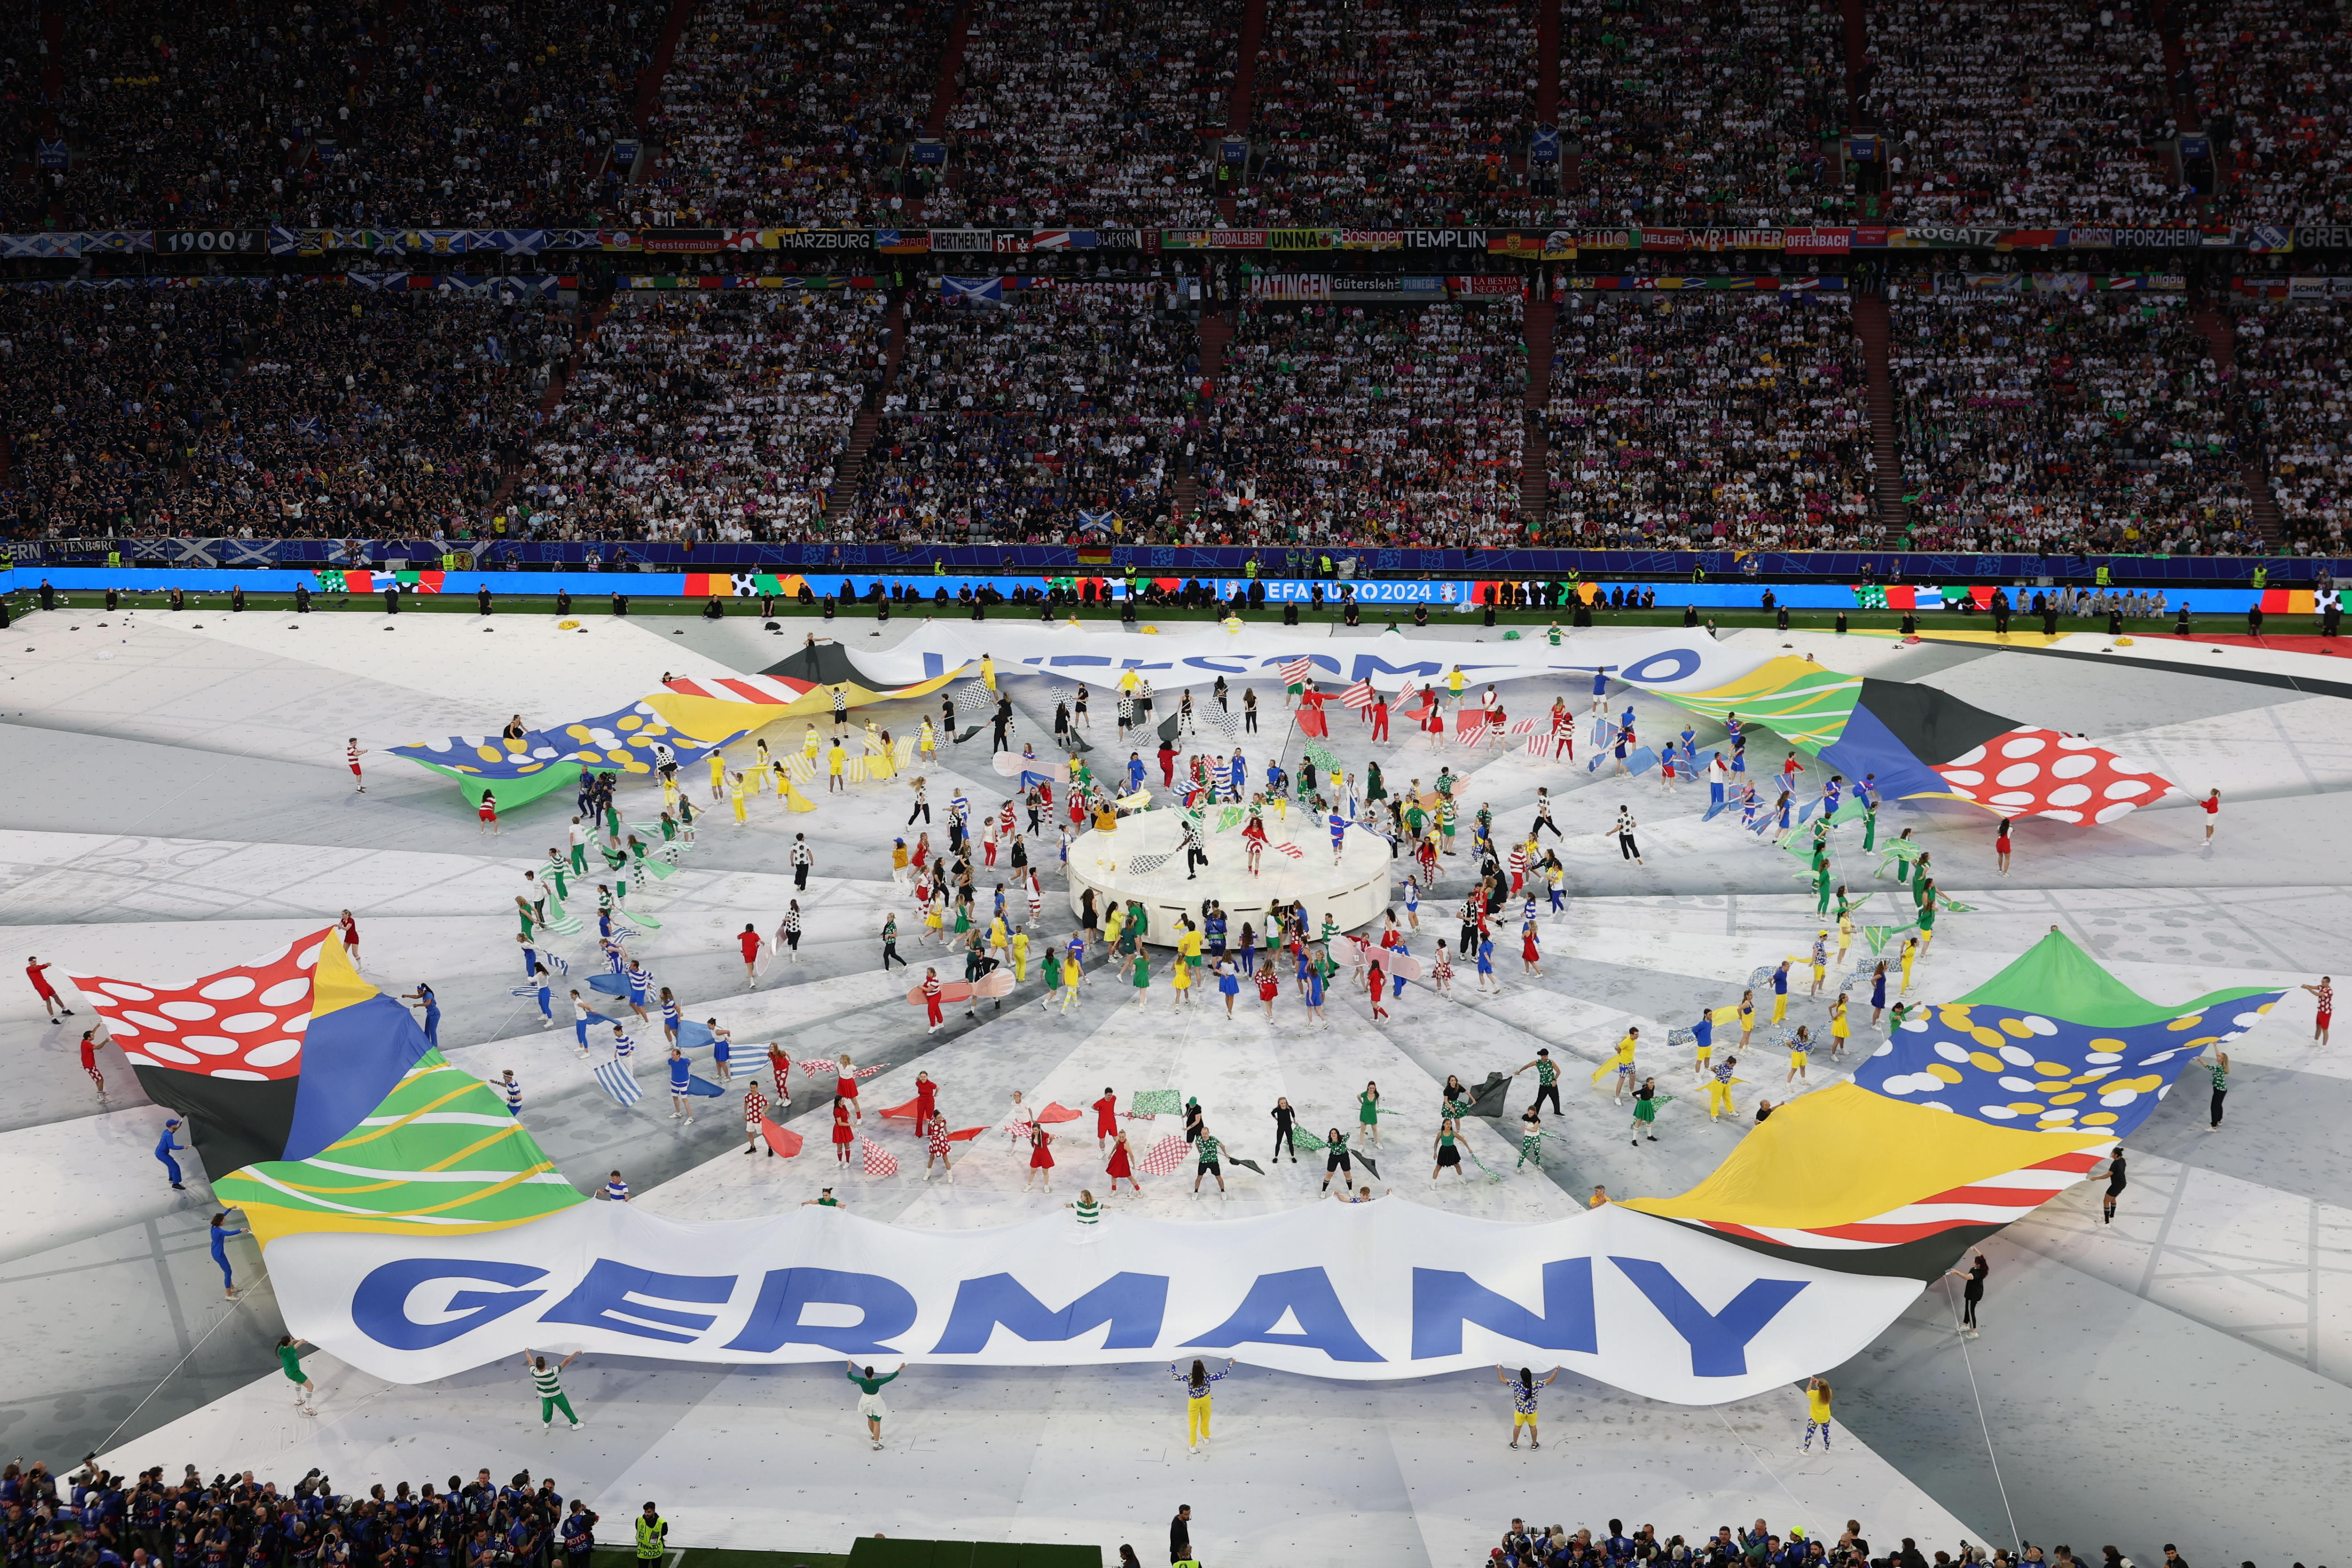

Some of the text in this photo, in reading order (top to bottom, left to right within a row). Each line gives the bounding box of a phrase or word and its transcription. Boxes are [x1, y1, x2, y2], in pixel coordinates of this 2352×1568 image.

[168, 231, 235, 252] 1900
[648, 240, 719, 250] Seestermühe
[782, 233, 870, 248] HARZBURG
[900, 237, 927, 247] STADT
[997, 234, 1015, 253] BT
[1171, 231, 1202, 242] HOLSEN
[1212, 232, 1262, 245] RODALBEN
[1271, 231, 1318, 248] UNNA
[1341, 228, 1404, 246] Bösingen
[1404, 231, 1486, 248] TEMPLIN
[1642, 233, 1684, 245] UELSEN
[1787, 234, 1849, 247] OFFENBACH
[2070, 228, 2112, 246] CHRISSI
[2115, 228, 2202, 246] PFORZHEIM
[1251, 273, 1331, 301] RATINGEN
[1404, 279, 1435, 289] PLANEGG
[2147, 273, 2184, 288] Allgäu
[1474, 285, 1518, 294] NEGRA 08
[9, 542, 41, 561] ERN
[1268, 582, 1306, 599] EFA
[1381, 586, 1432, 603] 2024
[352, 1255, 1809, 1377] GERMANY
